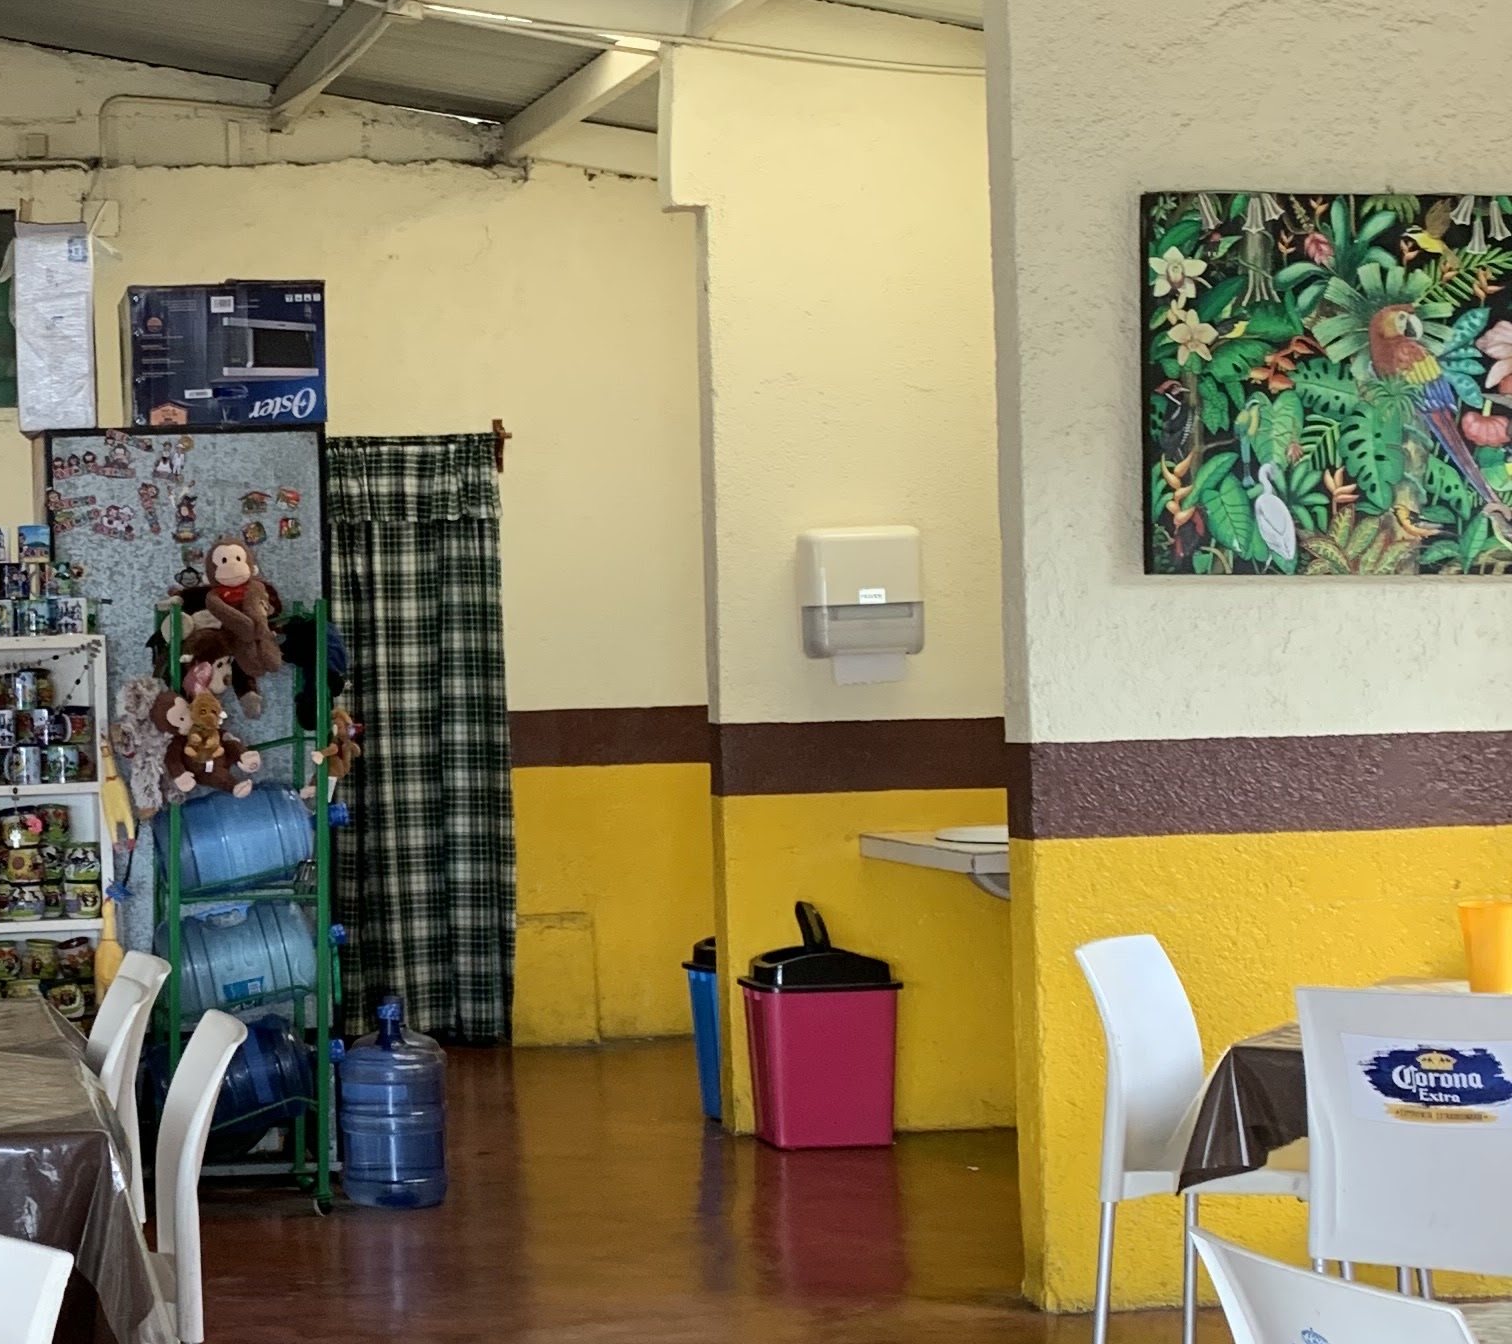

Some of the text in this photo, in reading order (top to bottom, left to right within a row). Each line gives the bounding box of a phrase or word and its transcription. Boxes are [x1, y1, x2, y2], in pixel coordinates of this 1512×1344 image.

[248, 387, 317, 419] Oster
[1391, 1064, 1484, 1092] Corona
[1419, 1088, 1461, 1103] Extra
